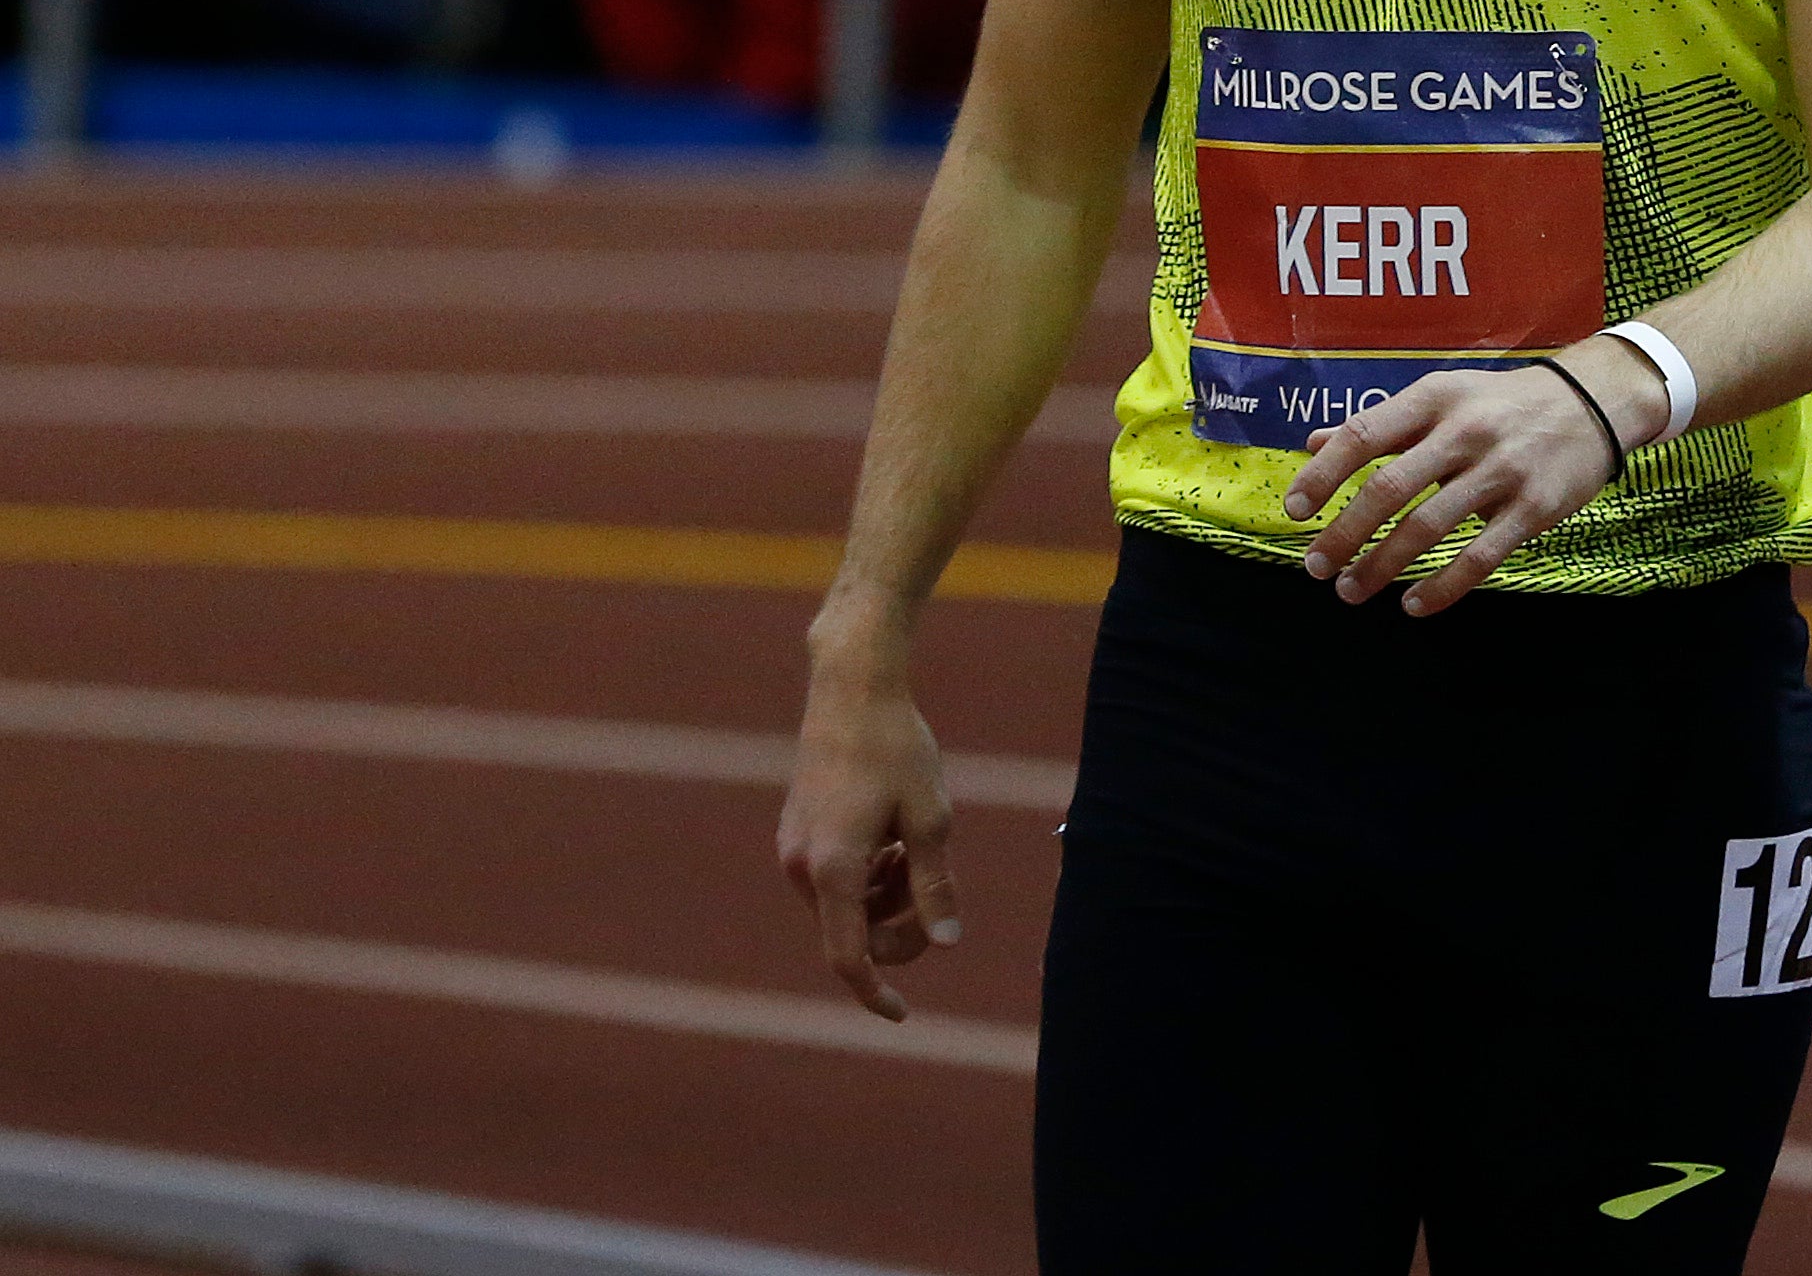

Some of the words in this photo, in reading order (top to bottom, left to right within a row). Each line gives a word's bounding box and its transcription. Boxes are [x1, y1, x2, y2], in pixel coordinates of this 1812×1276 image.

[1213, 69, 1397, 111] MILLROSE
[1409, 71, 1583, 111] GAMES
[1275, 205, 1470, 297] KERR
